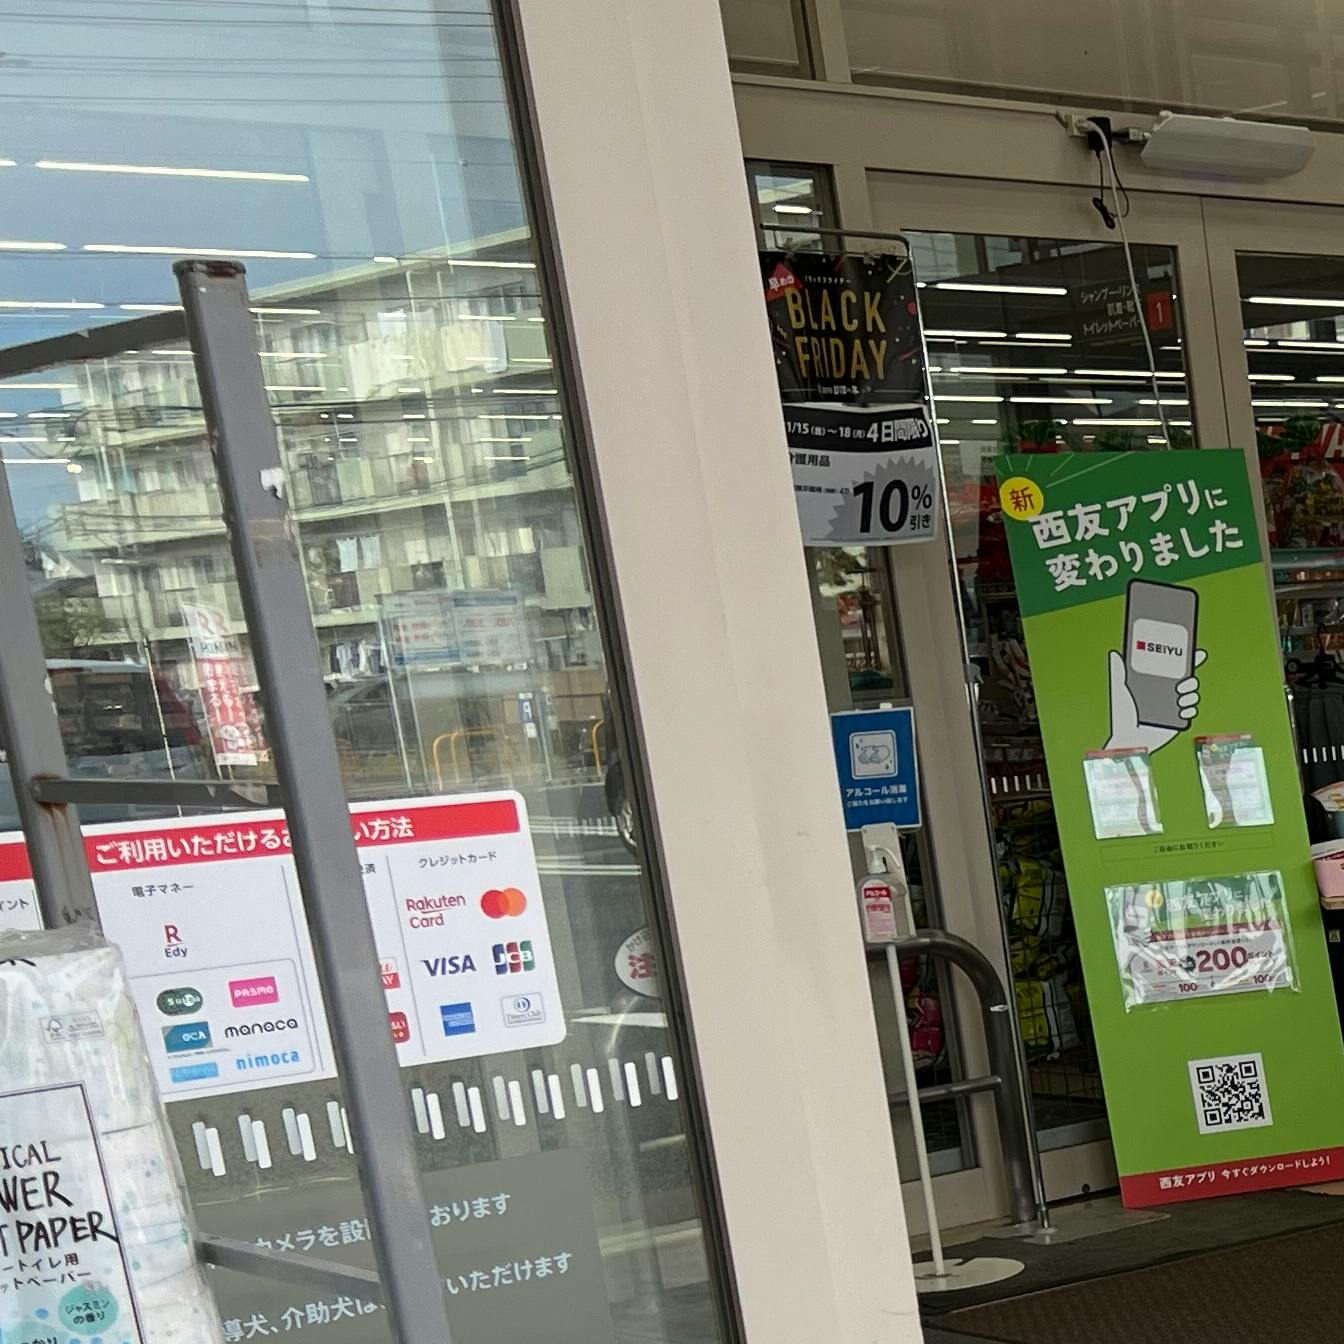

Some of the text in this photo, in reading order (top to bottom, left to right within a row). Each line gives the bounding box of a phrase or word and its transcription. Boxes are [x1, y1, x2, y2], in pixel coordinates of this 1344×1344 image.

[784, 288, 887, 333] BLACK
[1155, 301, 1164, 324] 1
[795, 335, 888, 381] FRIDAY
[852, 479, 933, 534] 10%
[1010, 486, 1036, 513] 新
[909, 514, 931, 531] 引き
[1028, 478, 1229, 550] 西友アプリに
[1045, 518, 1244, 592] 変わりました
[1146, 641, 1183, 657] SEIYU
[846, 783, 907, 798] アルコール消毒
[418, 851, 496, 869] クレジットカード
[132, 882, 194, 898] 電子マネー
[406, 893, 465, 912] Rakuten
[410, 913, 444, 929] Card
[165, 946, 187, 959] Edy
[493, 942, 535, 974] JCB
[423, 954, 477, 977] VISA
[234, 985, 274, 999] PASMO
[224, 1018, 298, 1038] manaca
[236, 1050, 299, 1070] nimoca
[1159, 1170, 1216, 1190] 西友アプリ
[430, 1192, 512, 1227] おります
[16, 1211, 119, 1254] PAPER
[64, 1299, 110, 1315] ジャスミン
[73, 1311, 105, 1325] の香り
